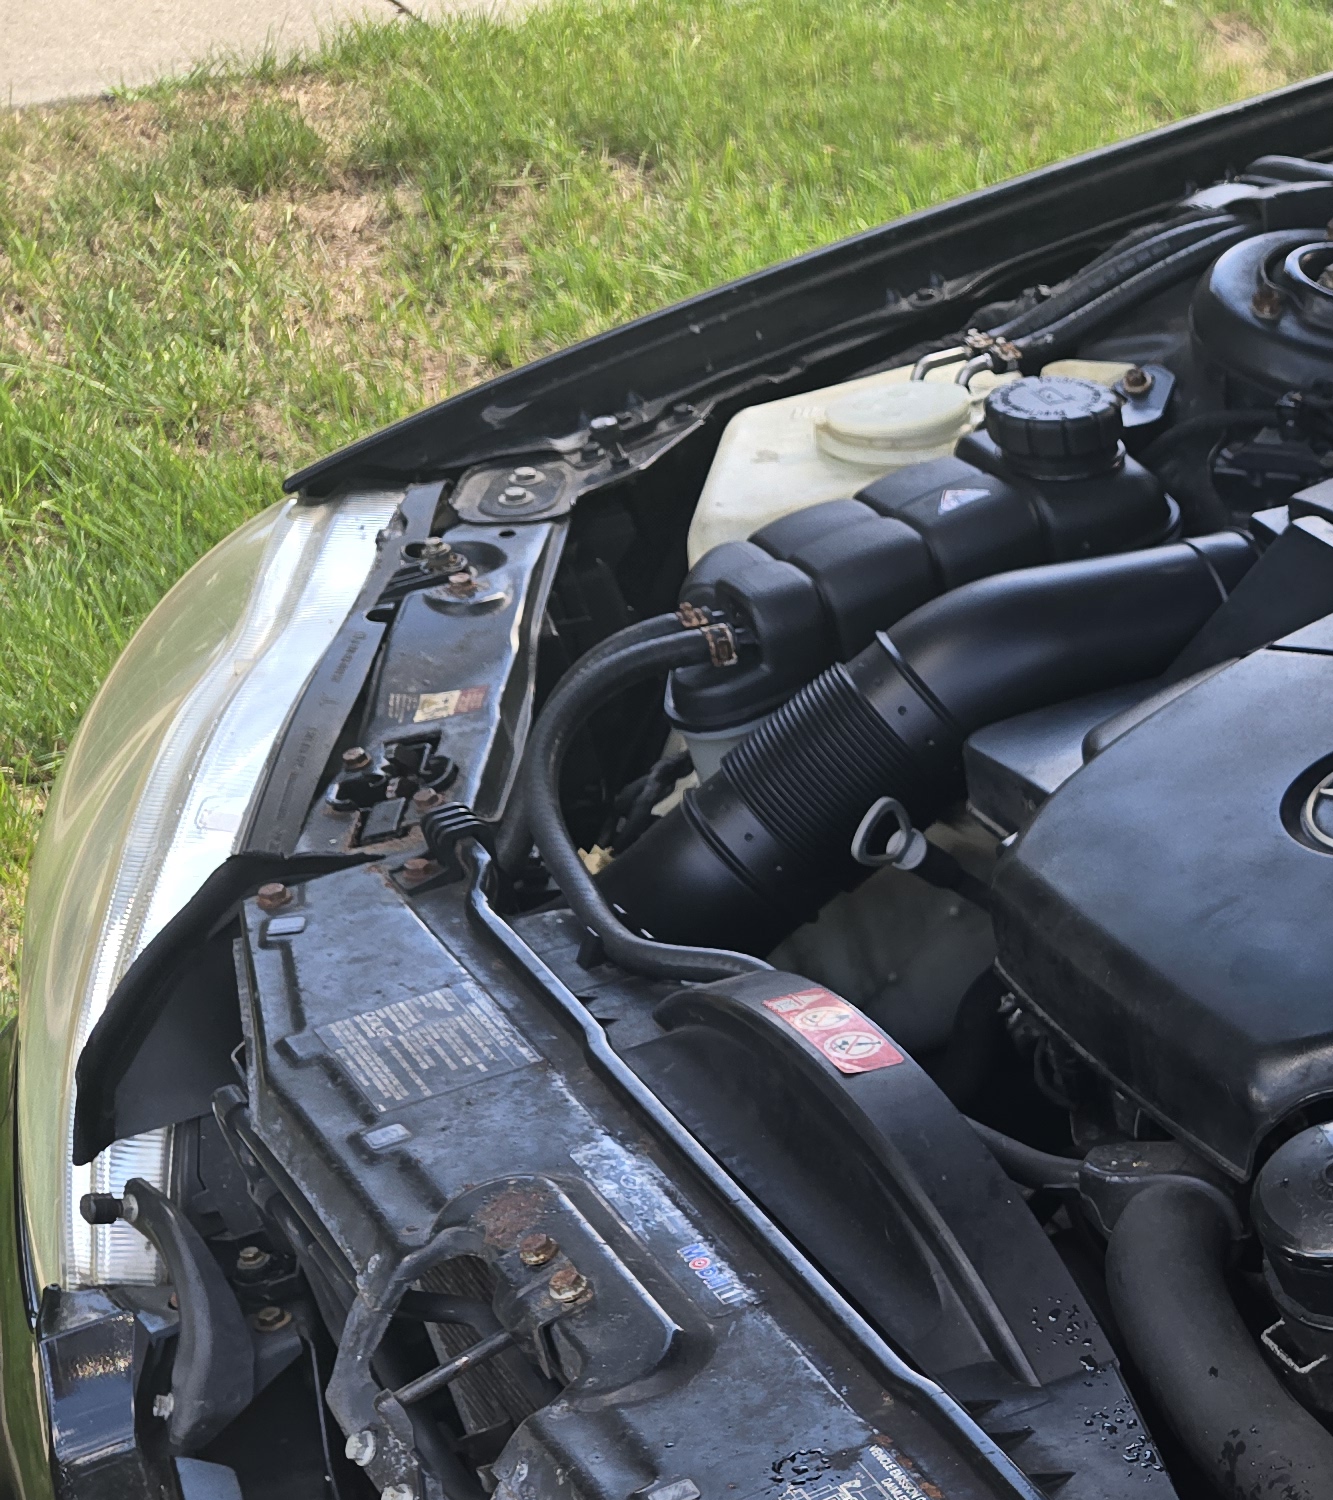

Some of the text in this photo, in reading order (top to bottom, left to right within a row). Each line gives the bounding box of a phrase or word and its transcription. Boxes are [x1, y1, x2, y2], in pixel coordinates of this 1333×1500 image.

[677, 1241, 729, 1290] Mobil
[869, 1445, 897, 1471] VEHICLE
[889, 1468, 922, 1499] EMISSION
